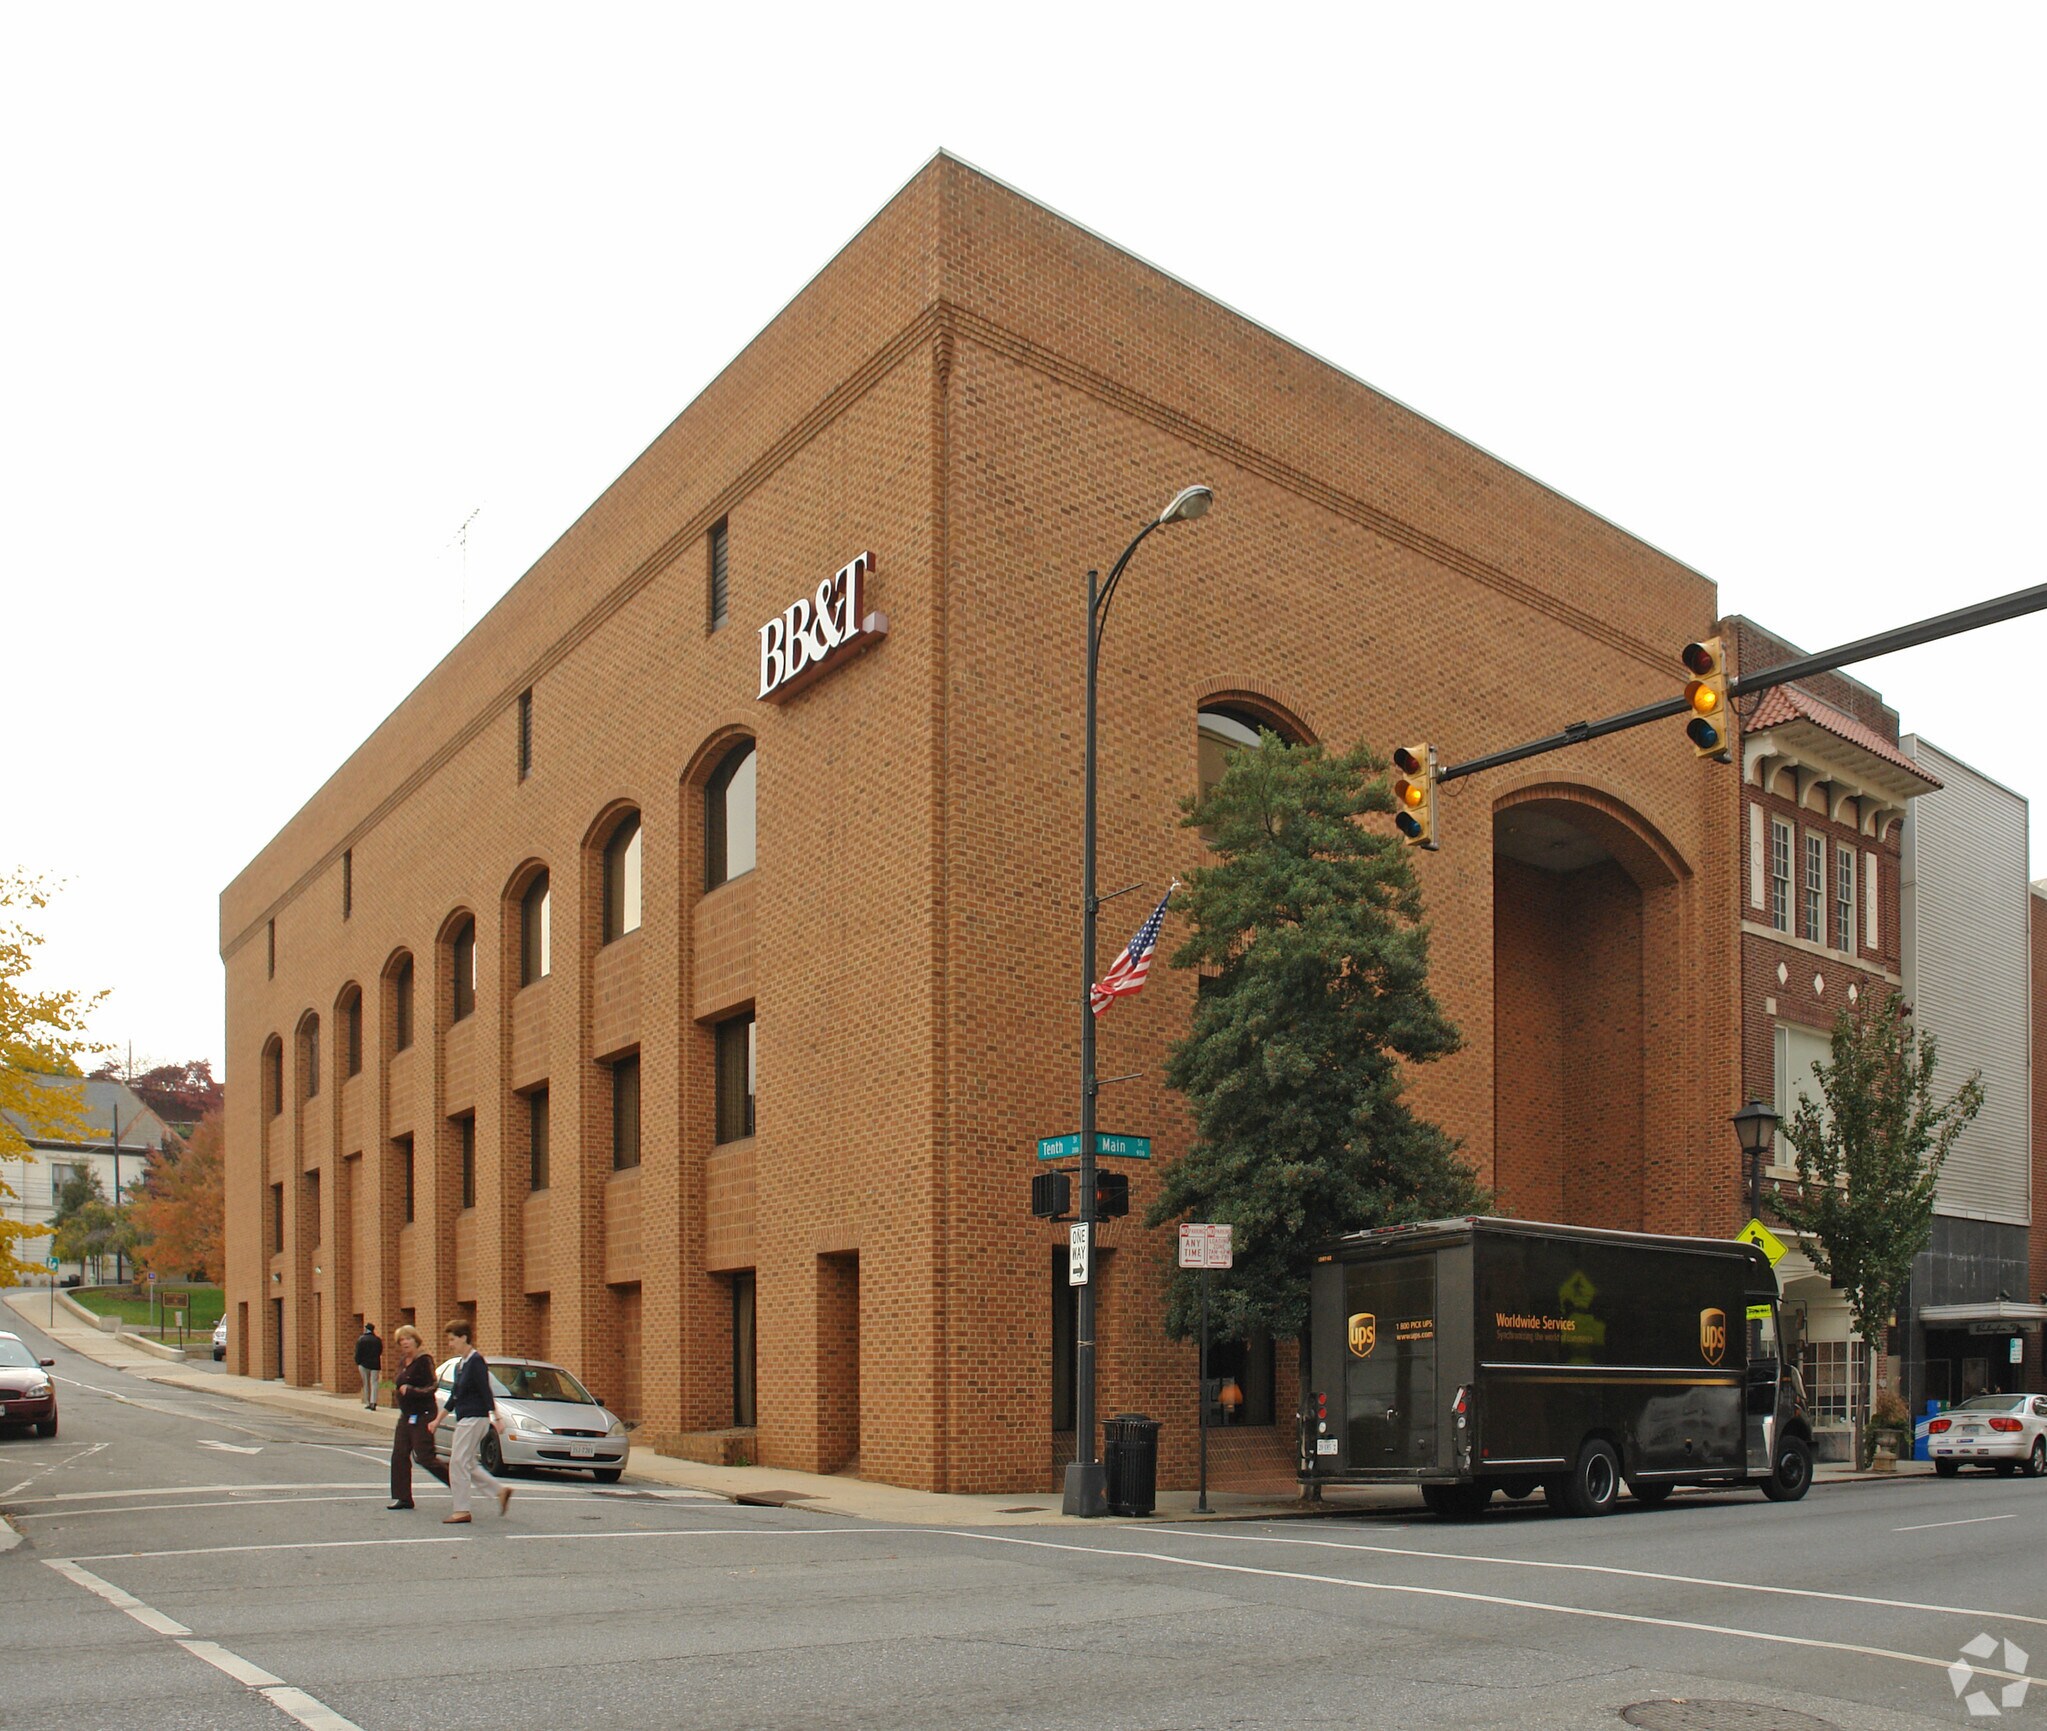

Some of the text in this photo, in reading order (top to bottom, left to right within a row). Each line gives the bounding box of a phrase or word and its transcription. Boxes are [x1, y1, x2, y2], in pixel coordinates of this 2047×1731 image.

[757, 551, 872, 700] BB&T
[1043, 1141, 1063, 1156] Tenth
[1103, 1138, 1143, 1153] Main St
[1073, 1229, 1086, 1245] ONE
[1186, 1239, 1201, 1247] ANY
[1072, 1245, 1086, 1261] WAY
[1184, 1249, 1201, 1257] TIME
[1400, 1322, 1410, 1331] 800
[1411, 1321, 1422, 1329] PICK
[1423, 1320, 1433, 1328] UPS
[1496, 1313, 1576, 1331] Worldwide Services
[1351, 1326, 1374, 1351] ups
[1397, 1332, 1434, 1341] www.ups.com
[1702, 1326, 1724, 1357] ups
